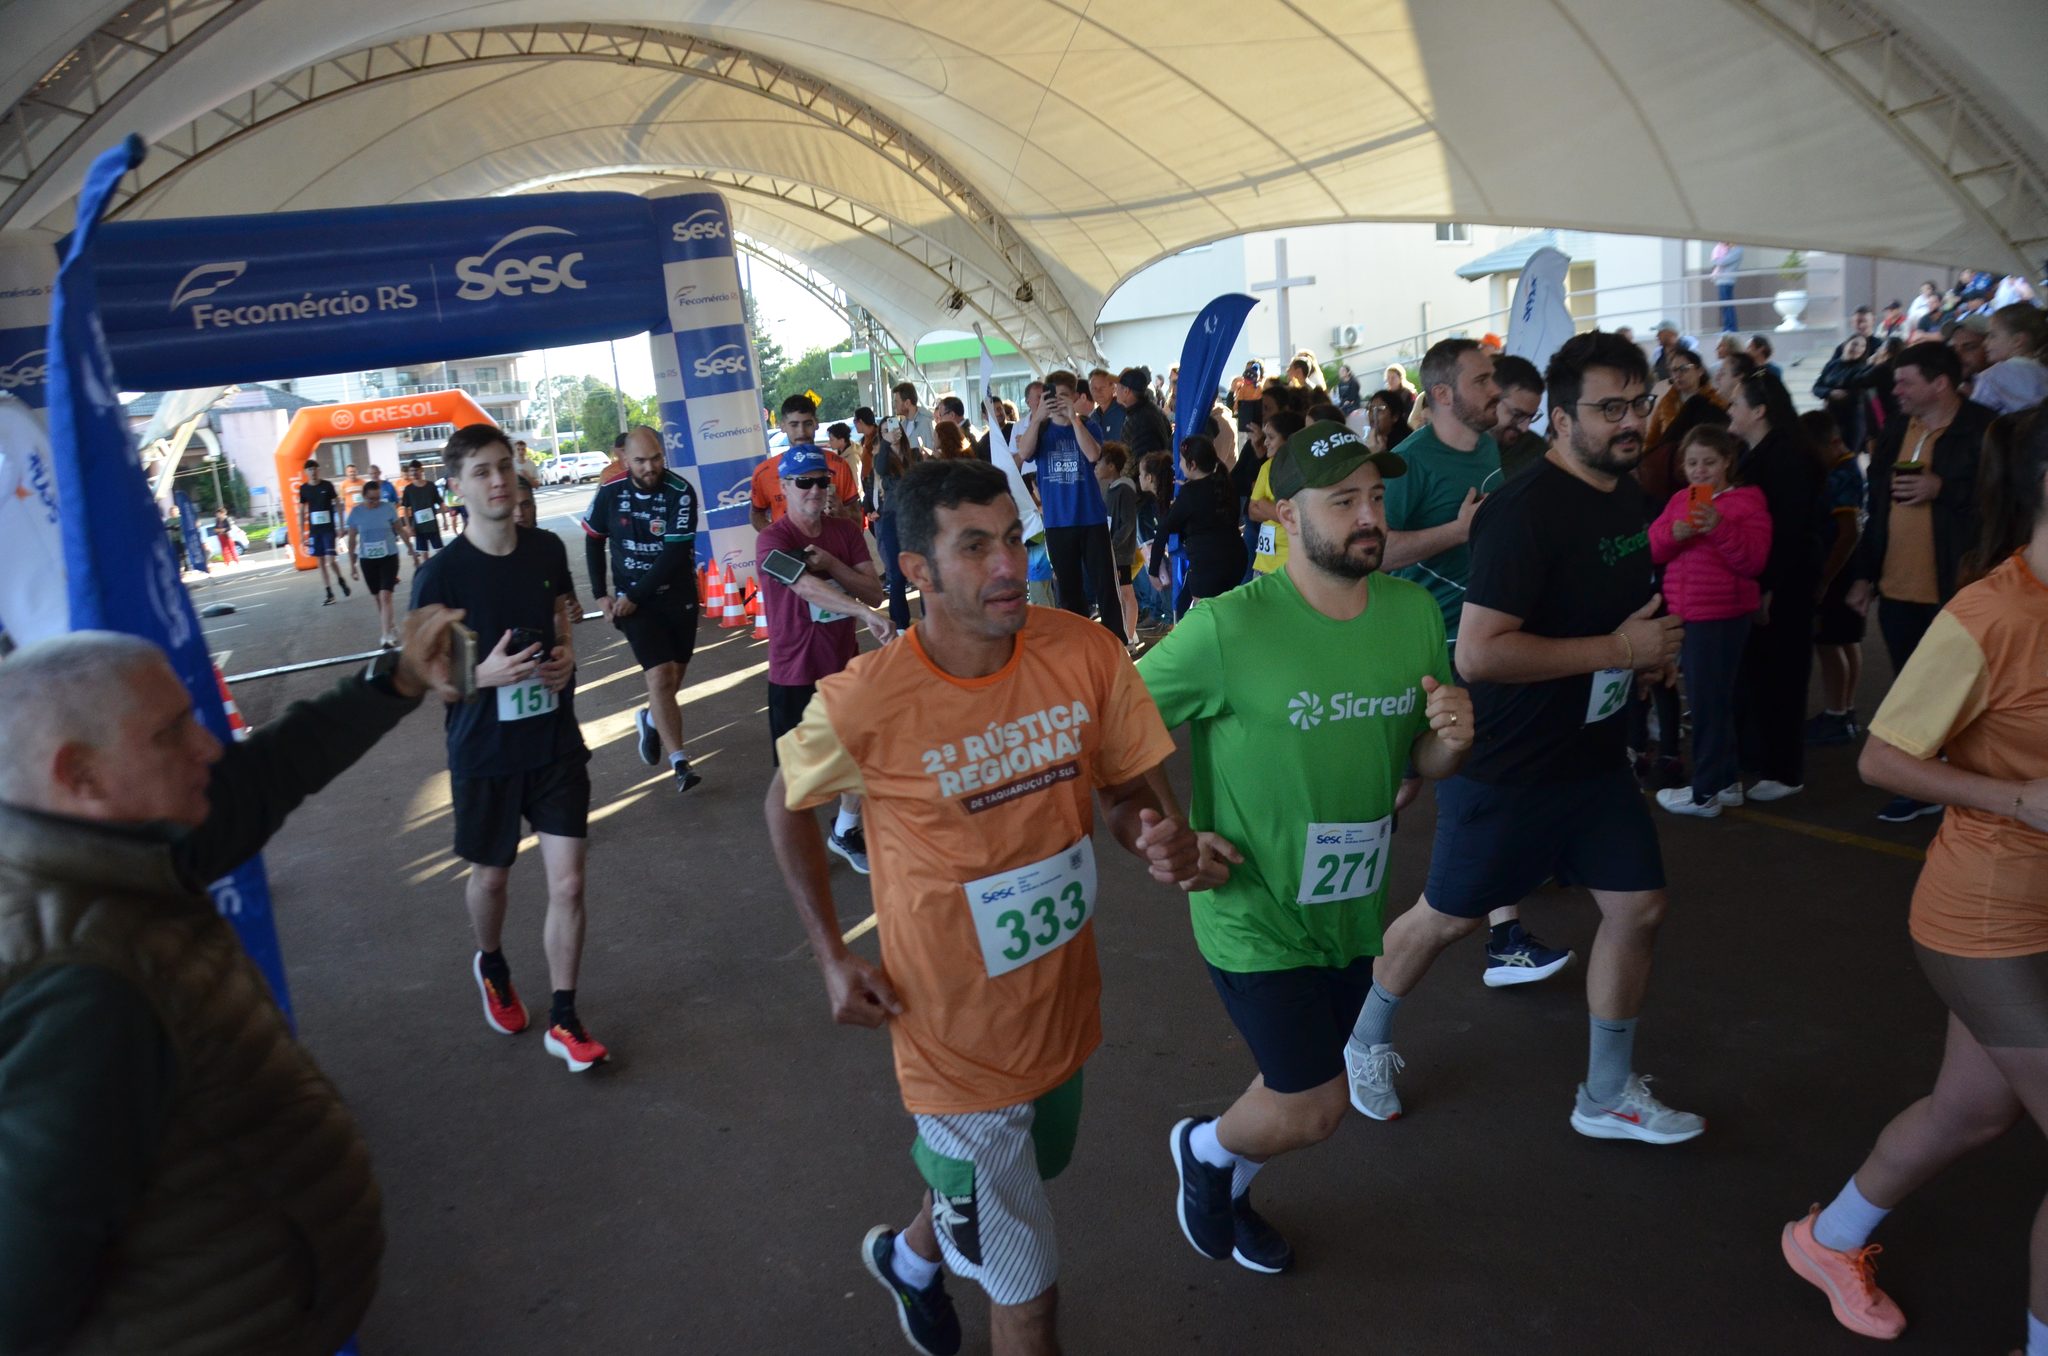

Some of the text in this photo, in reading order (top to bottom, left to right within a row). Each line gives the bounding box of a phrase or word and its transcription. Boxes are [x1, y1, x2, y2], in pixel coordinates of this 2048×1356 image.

[672, 219, 726, 243] Sesc
[455, 248, 588, 301] Sesc
[191, 283, 419, 331] Fecomércio RS
[679, 293, 730, 307] Fecomércio
[0, 363, 51, 389] Ses
[693, 353, 748, 378] Sesc
[359, 401, 440, 425] CRESOL
[703, 425, 753, 441] Fecomércio
[676, 506, 692, 530] URI
[1329, 687, 1417, 722] Sicredi
[962, 699, 1091, 763] RÚSTICA
[970, 799, 985, 810] DE
[985, 777, 1043, 805] TAQUARUÇU
[1058, 765, 1077, 777] SUL
[1311, 847, 1380, 897] 271
[995, 880, 1087, 961] 333
